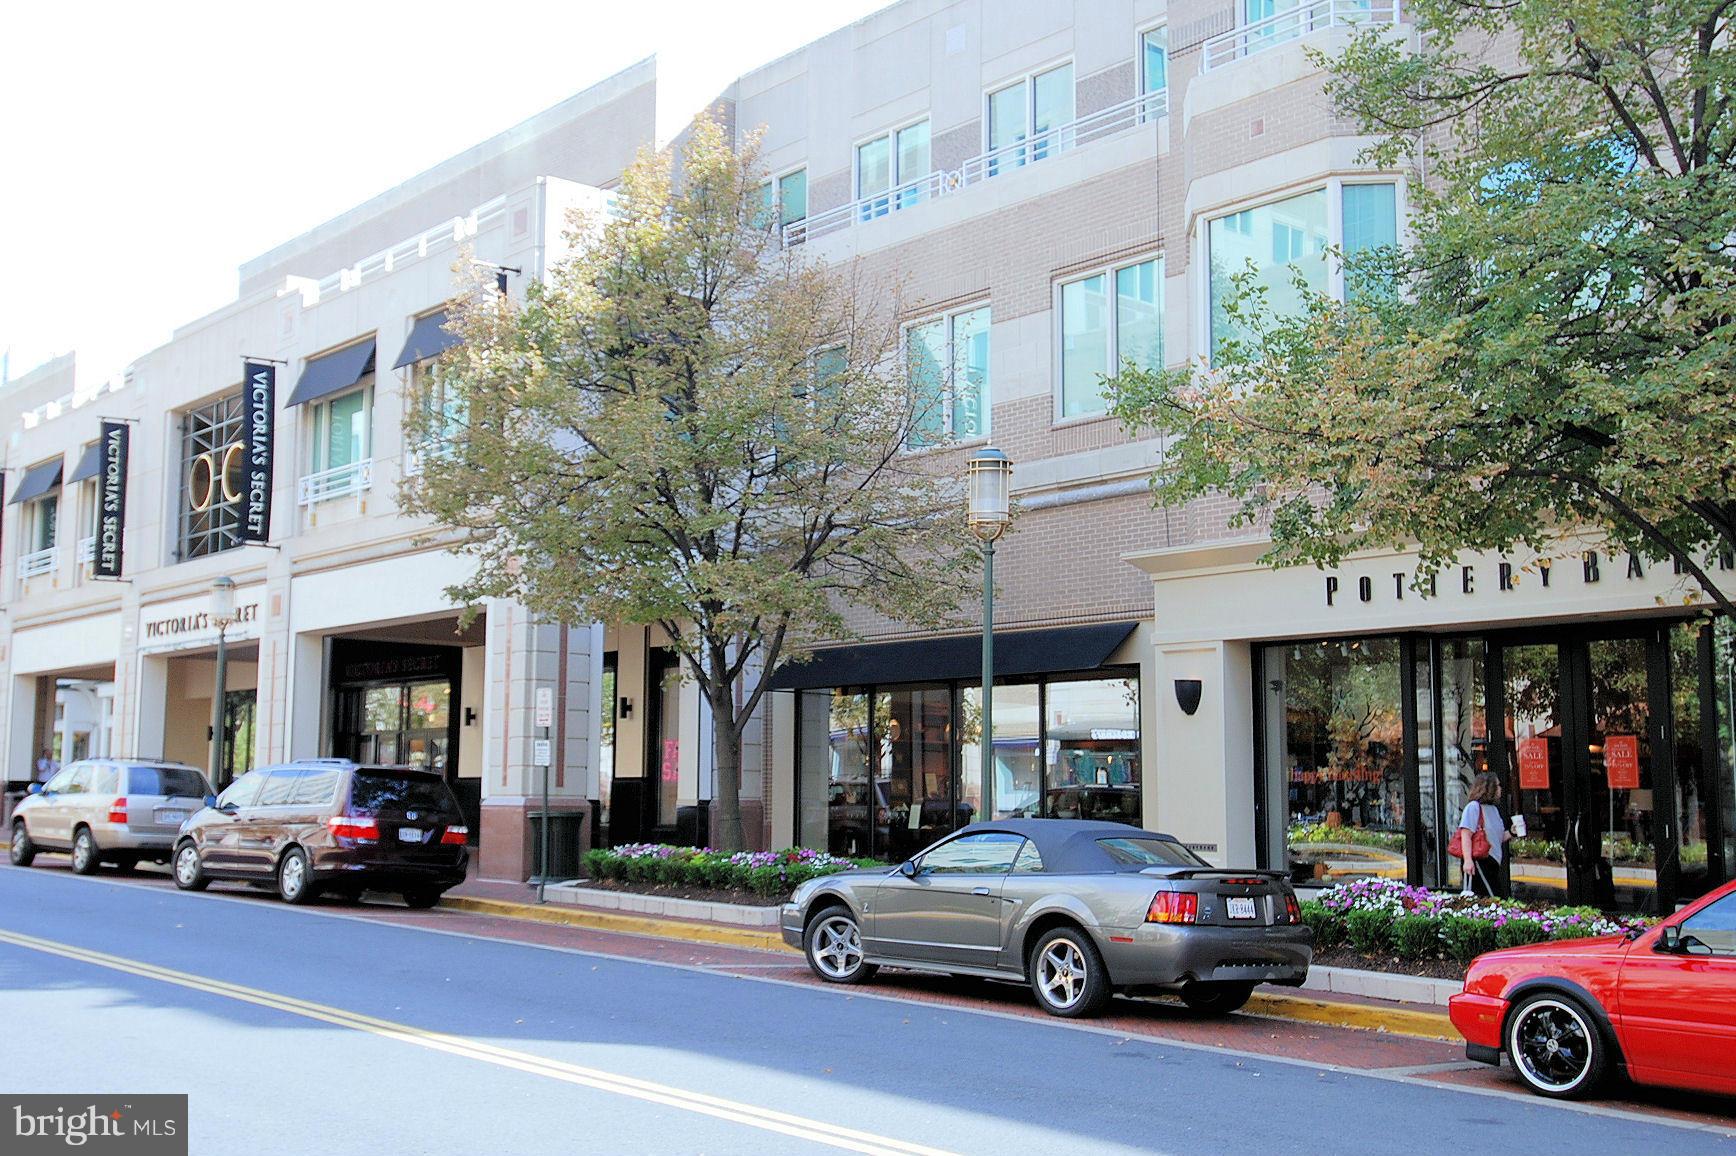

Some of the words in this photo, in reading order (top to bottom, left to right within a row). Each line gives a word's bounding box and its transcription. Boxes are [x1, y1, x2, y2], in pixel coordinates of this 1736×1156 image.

[251, 370, 269, 467] VICTORIA'S
[104, 428, 122, 512] VICTORIA'S
[247, 470, 266, 536] SECRET
[101, 515, 118, 572] SECRET
[1326, 556, 1551, 607] POTTERY
[146, 612, 208, 638] VICTORIA'S
[1522, 752, 1544, 760] SALE
[1611, 750, 1633, 758] SALE
